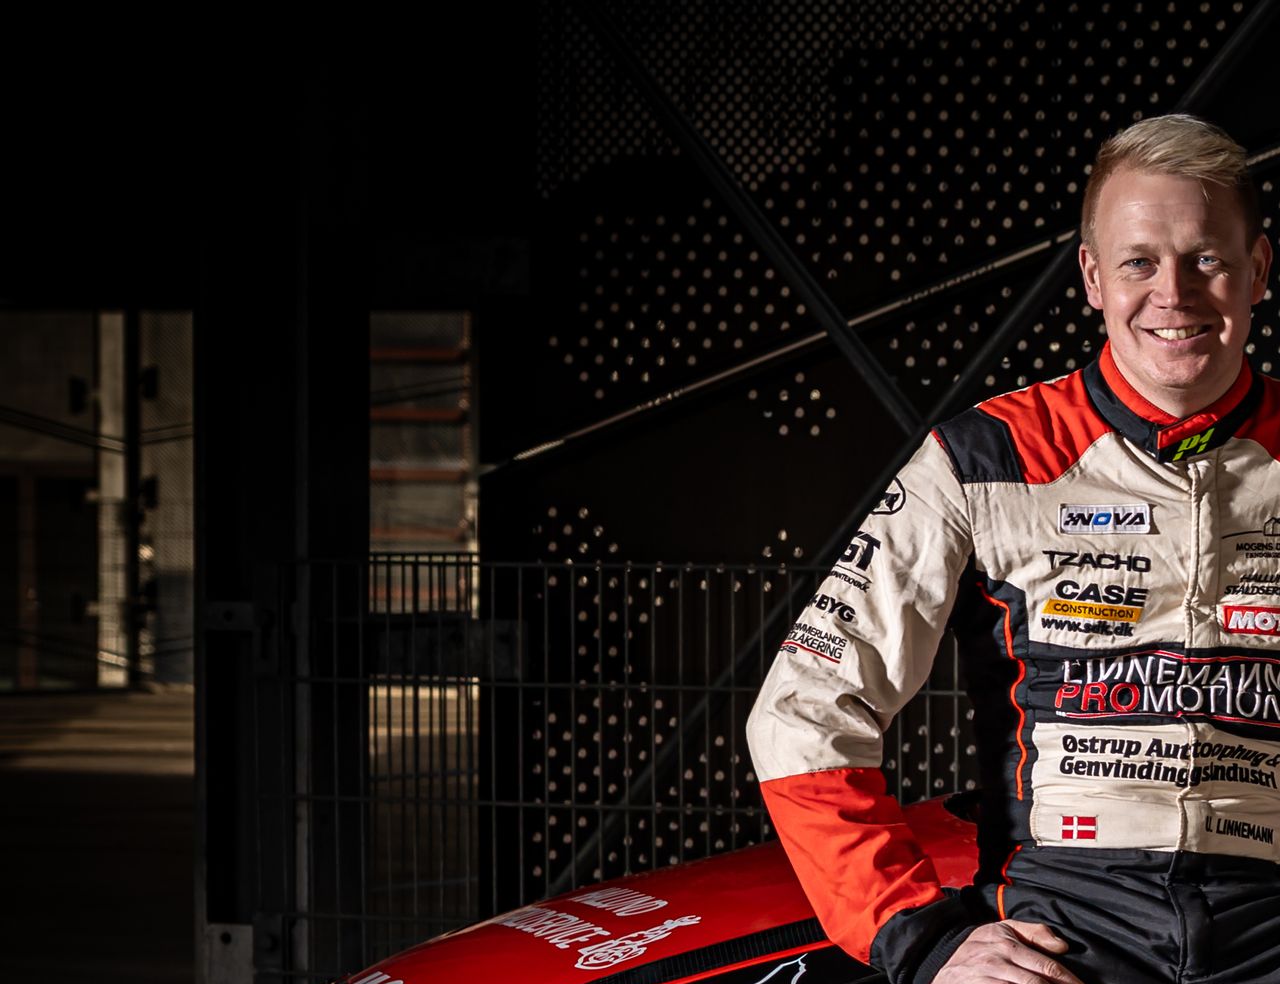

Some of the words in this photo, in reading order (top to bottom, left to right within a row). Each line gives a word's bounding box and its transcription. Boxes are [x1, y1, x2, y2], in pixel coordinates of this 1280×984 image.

[1042, 550, 1152, 573] TZACHO
[1055, 580, 1149, 607] CASE
[1053, 602, 1134, 618] CONSTRUCTION
[1062, 734, 1142, 757] Østrup
[1205, 816, 1214, 833] U.
[1216, 818, 1274, 845] LINNEMANN
